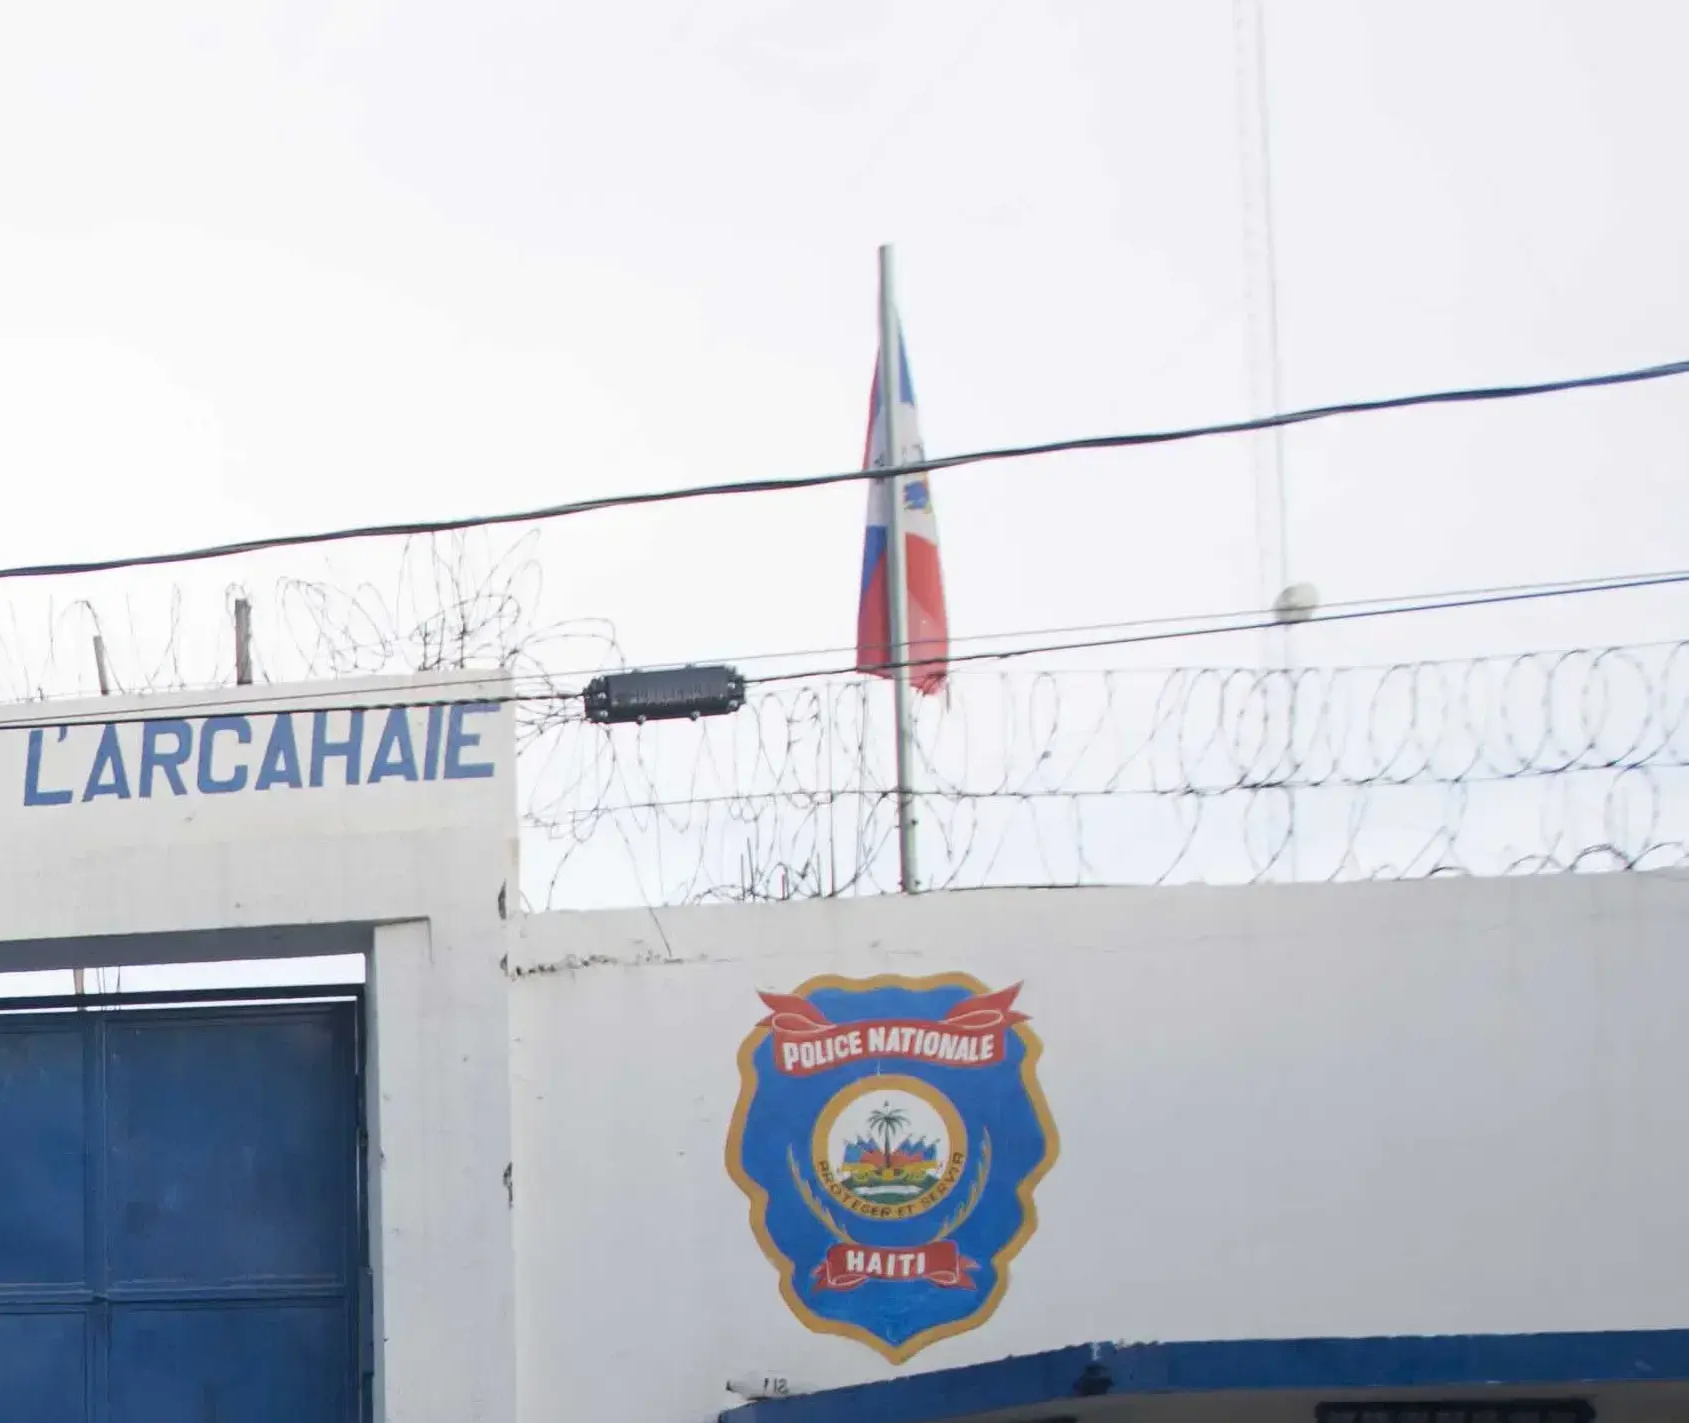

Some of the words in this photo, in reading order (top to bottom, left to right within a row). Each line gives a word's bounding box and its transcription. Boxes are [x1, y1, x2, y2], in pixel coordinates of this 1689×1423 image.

[23, 702, 501, 807] L'ARCAHAIE
[783, 1030, 863, 1071] POLICE
[867, 1026, 995, 1062] NATIONALE
[846, 1250, 926, 1276] HAITI
